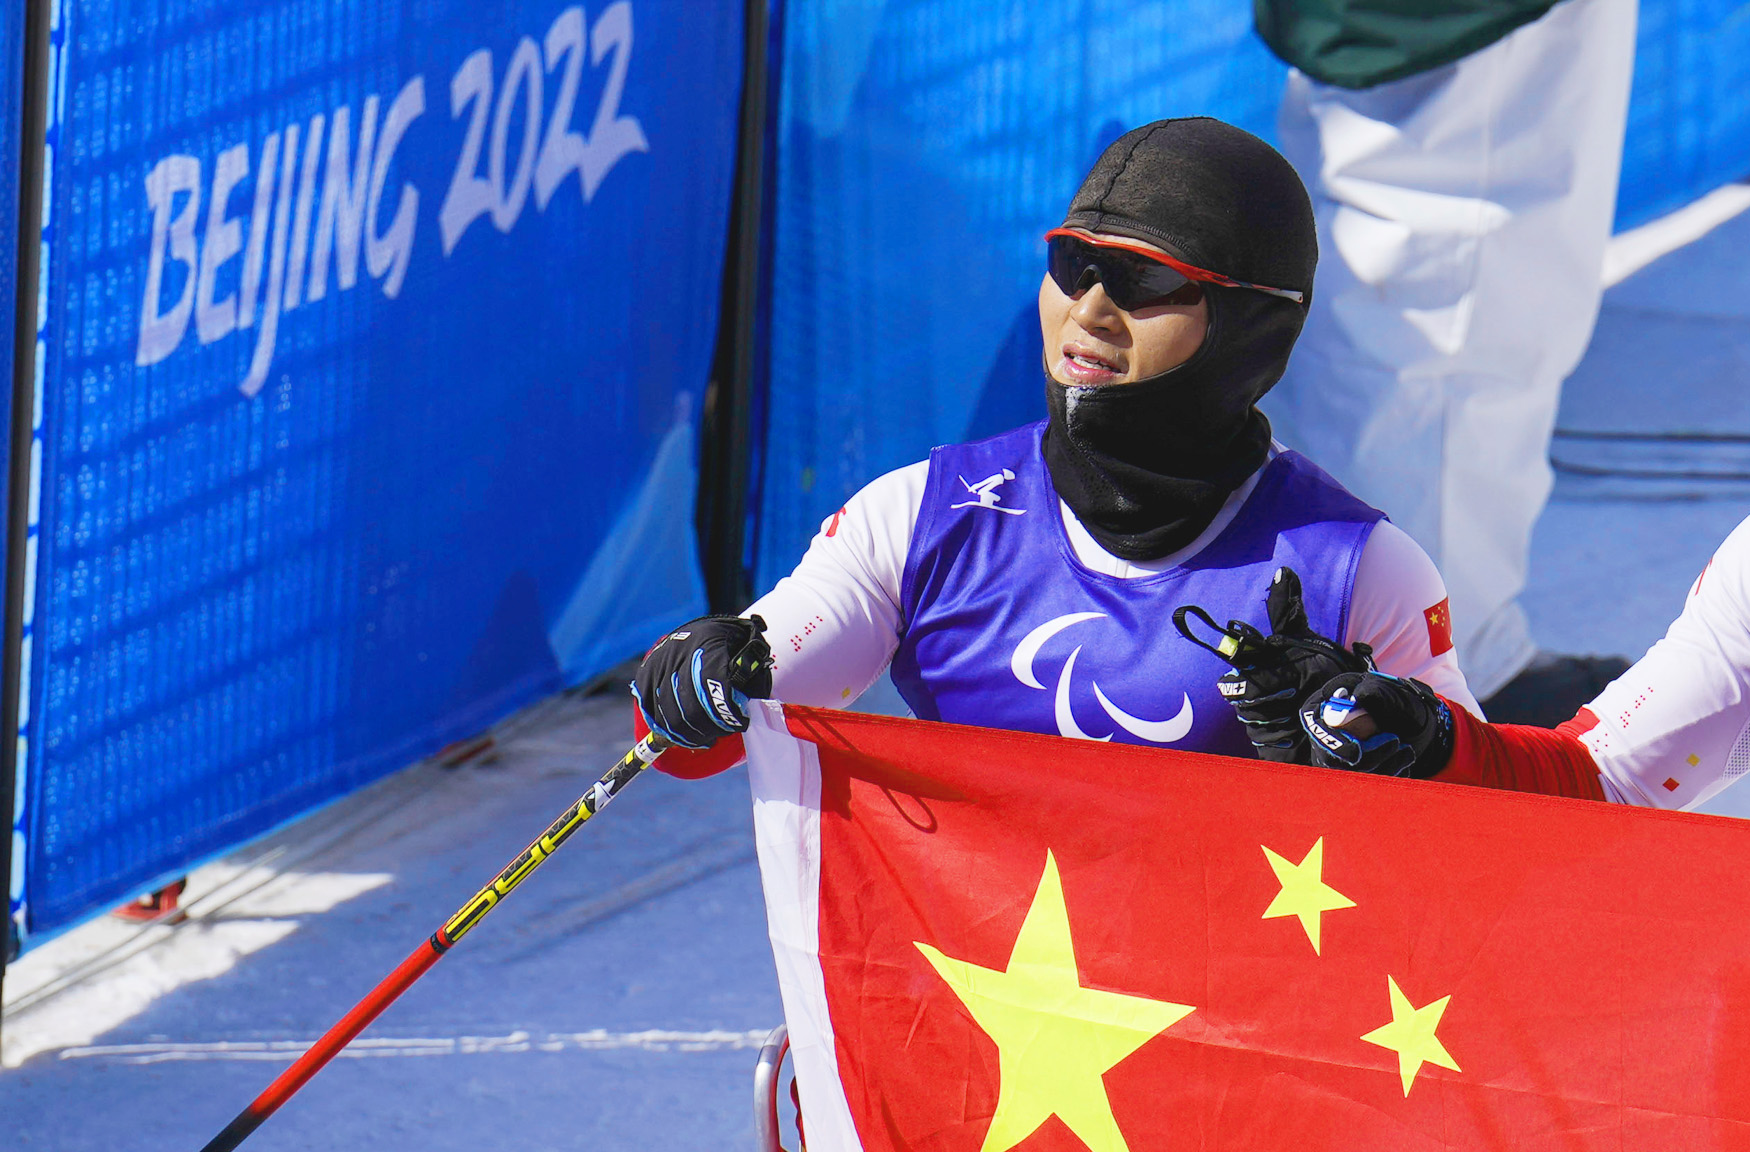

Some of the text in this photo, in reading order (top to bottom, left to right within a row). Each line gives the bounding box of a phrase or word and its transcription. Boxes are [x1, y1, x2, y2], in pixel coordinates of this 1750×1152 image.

[136, 0, 650, 398] BEIJING 2022
[706, 678, 743, 727] KV+
